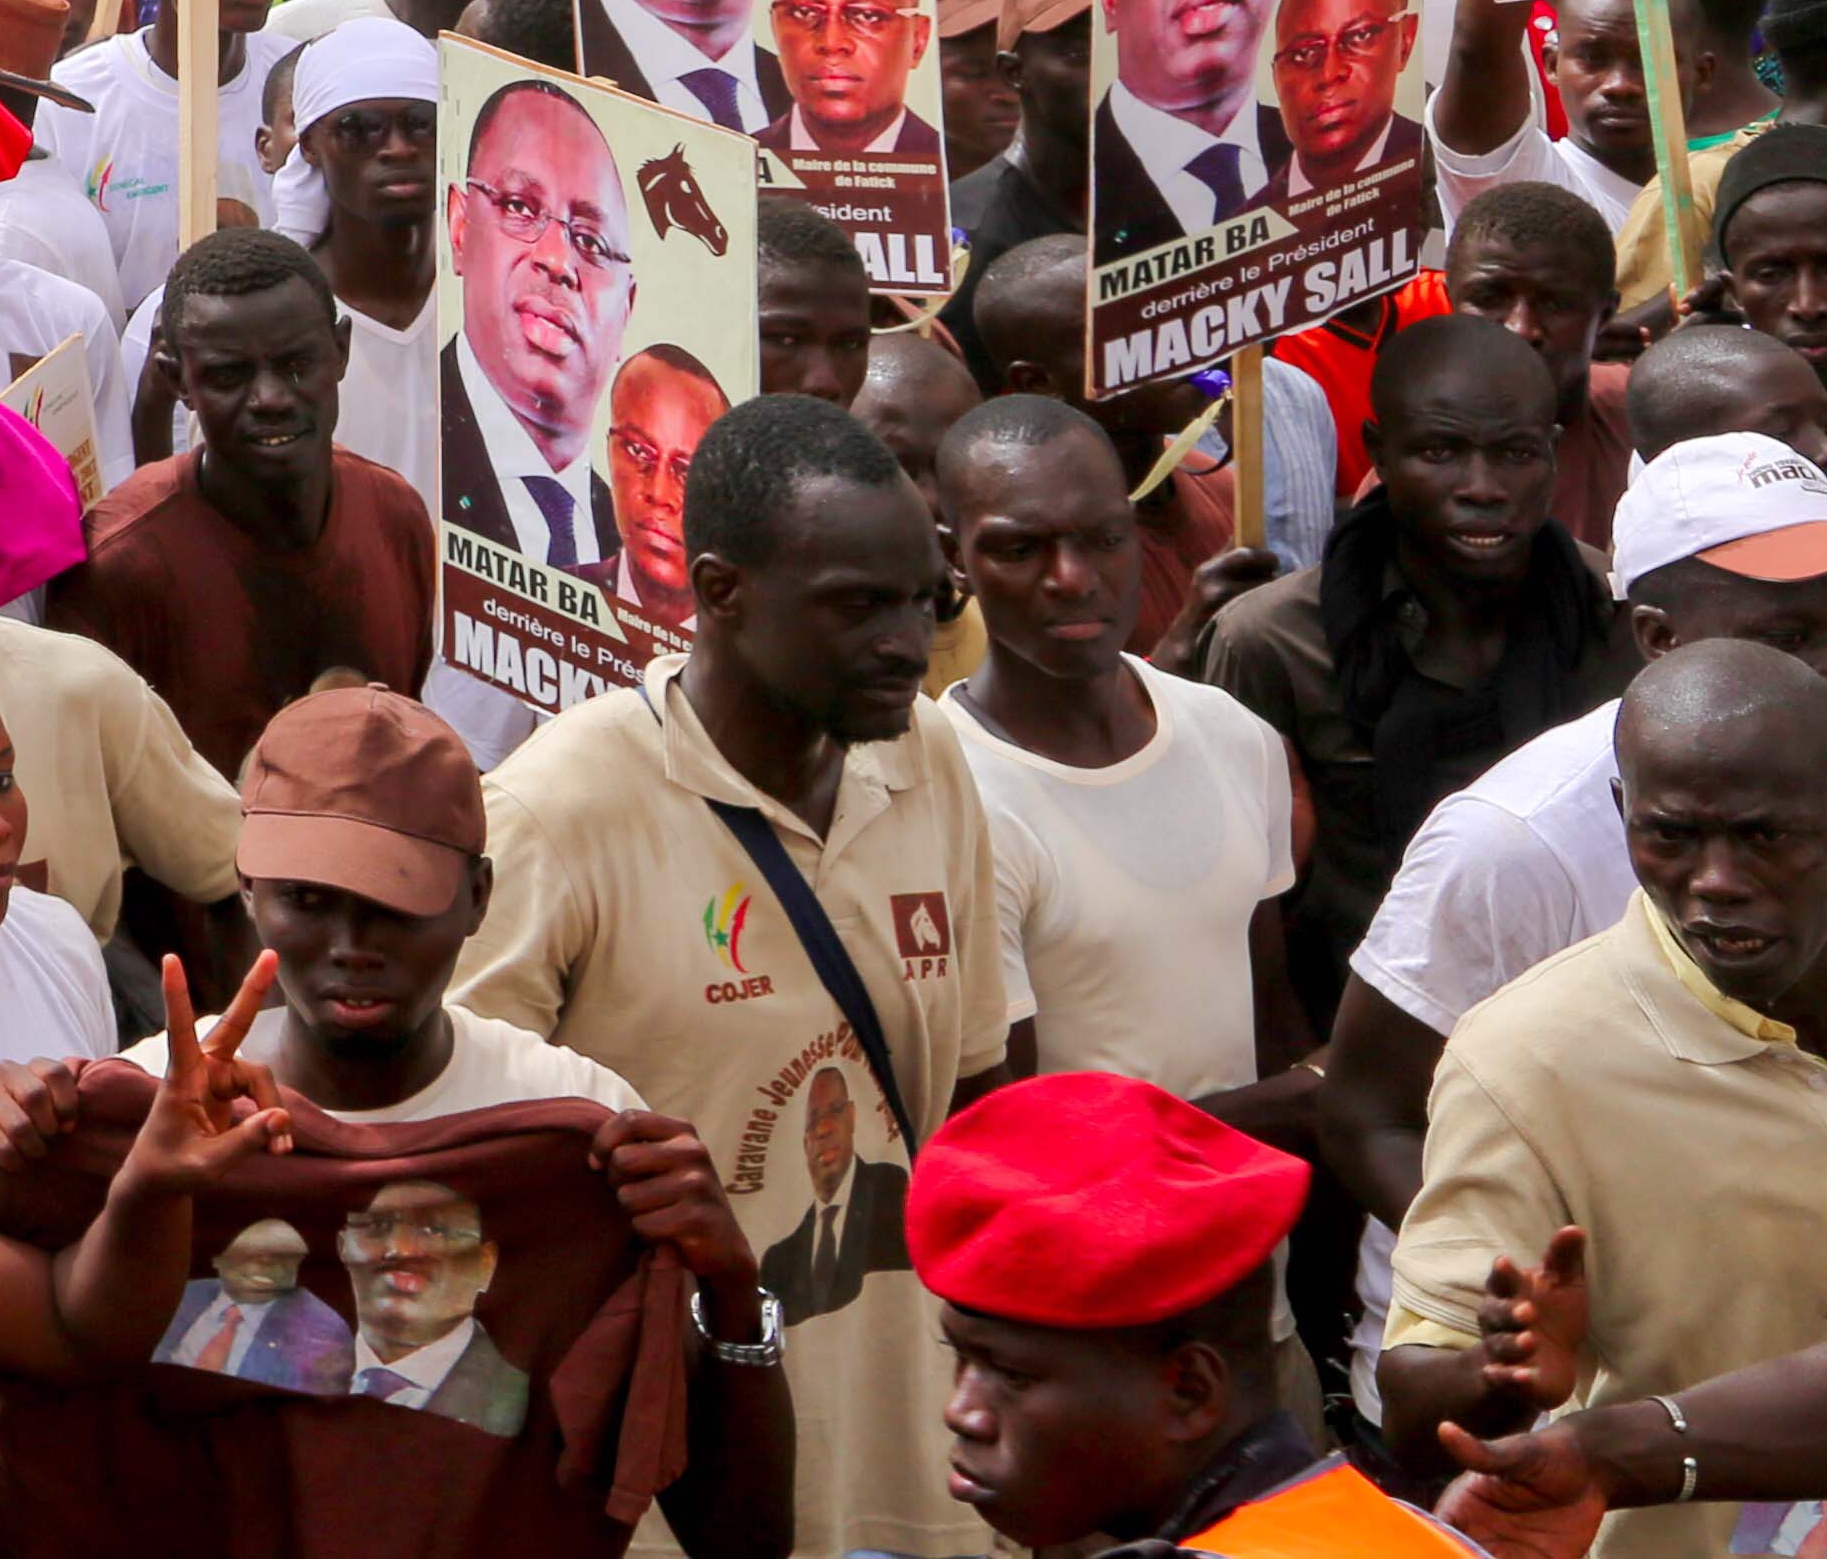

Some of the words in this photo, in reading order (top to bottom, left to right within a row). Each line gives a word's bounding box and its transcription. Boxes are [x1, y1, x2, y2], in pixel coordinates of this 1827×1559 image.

[792, 158, 832, 172] Maire
[833, 160, 851, 172] de
[852, 160, 867, 173] la
[868, 162, 938, 175] commune
[834, 175, 853, 188] de
[854, 175, 897, 189] Fatick
[1287, 196, 1325, 217] Maire
[1325, 189, 1344, 204] de
[1342, 183, 1357, 198] la
[1356, 158, 1416, 192] commune
[1325, 202, 1344, 218] de
[1343, 188, 1381, 212] Fatick
[854, 232, 945, 285] ALL
[1099, 238, 1216, 302] MATAR
[1226, 214, 1272, 257] BA
[1140, 274, 1235, 321] derrière
[1240, 262, 1262, 284] le
[1267, 216, 1377, 274] Président
[1103, 274, 1294, 390] MACKY
[1303, 226, 1415, 315] SALL
[446, 530, 549, 604] MATAR
[558, 578, 600, 627] BA
[482, 597, 565, 647] derrière
[571, 634, 591, 659] le
[704, 974, 776, 1006] COJER
[724, 1108, 779, 1196] Caravane
[756, 1030, 837, 1107] Jeunesse
